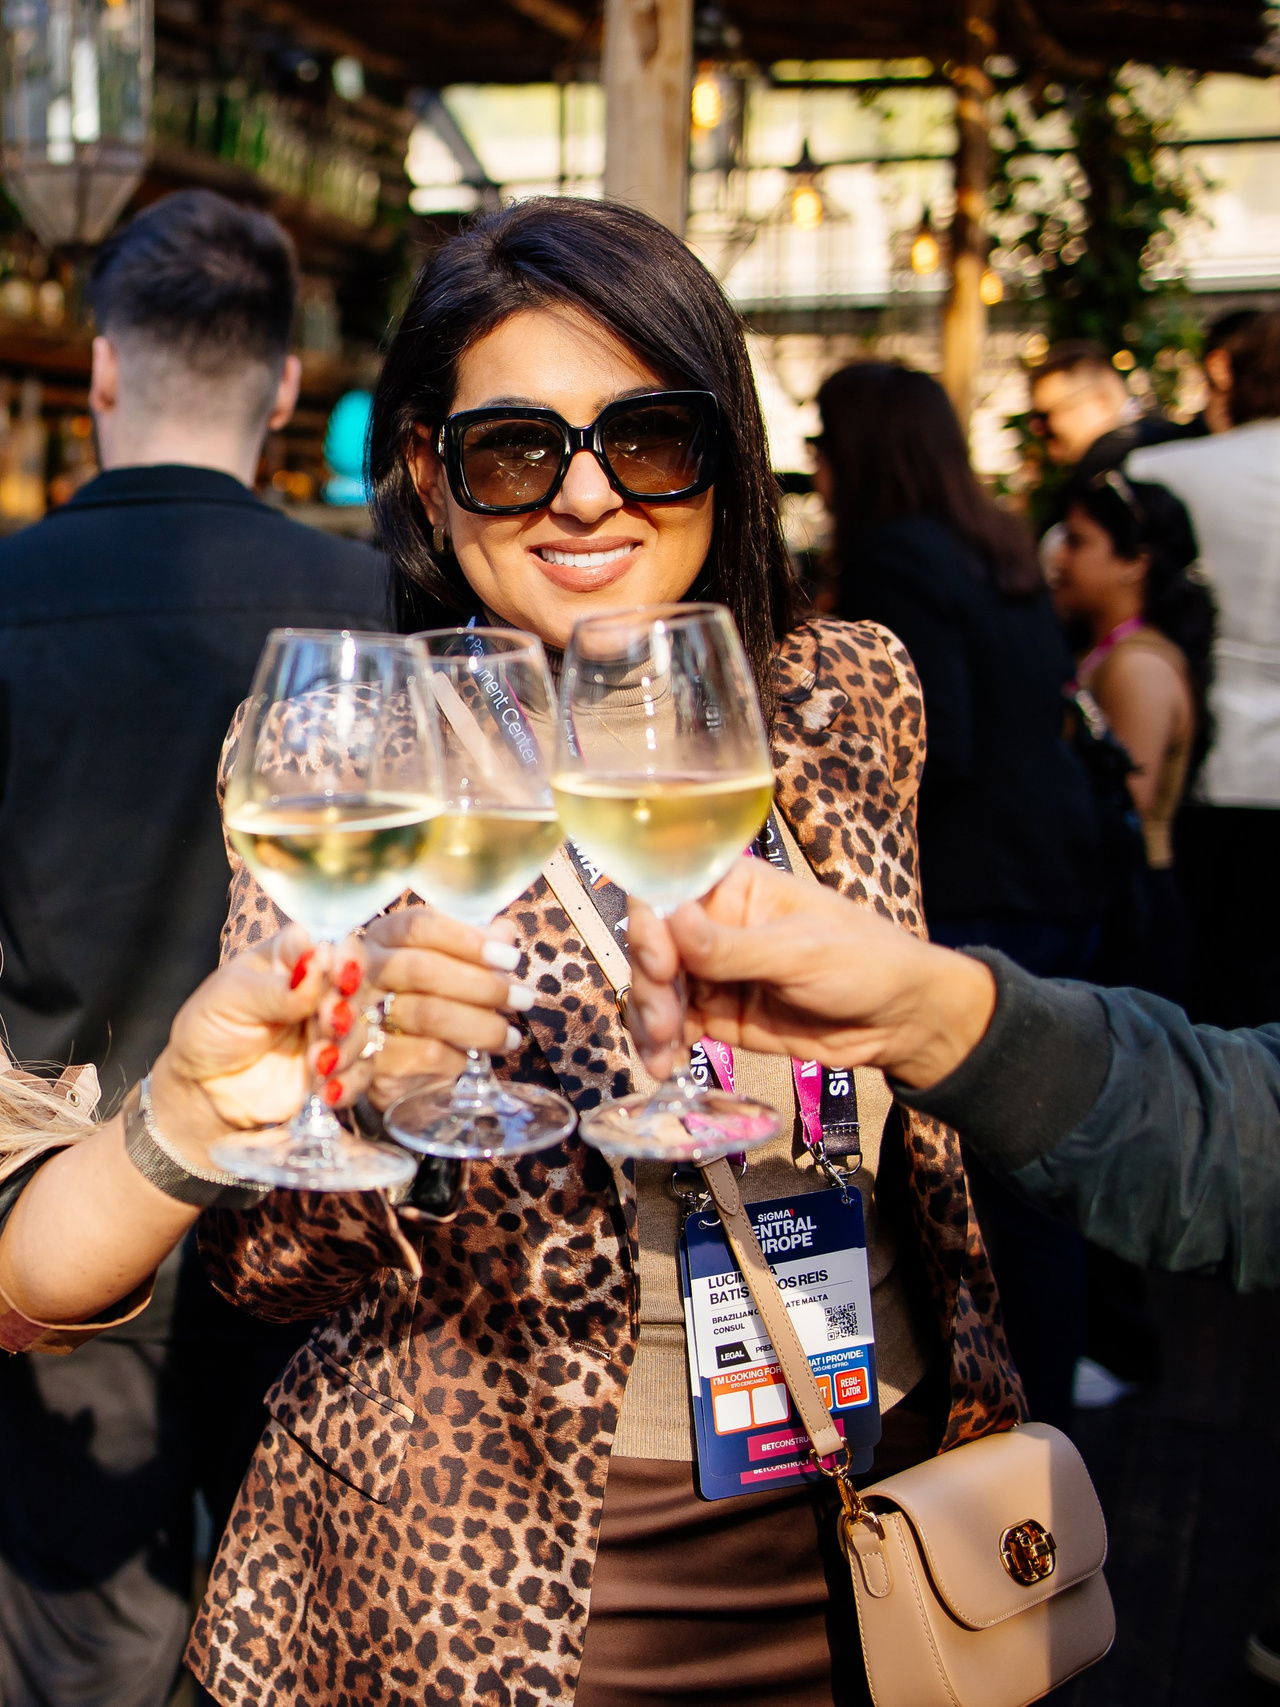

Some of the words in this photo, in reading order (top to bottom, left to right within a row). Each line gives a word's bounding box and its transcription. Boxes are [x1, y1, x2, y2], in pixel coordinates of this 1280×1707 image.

[501, 707, 538, 766] Center
[757, 1209, 791, 1223] SiGMA
[752, 1216, 818, 1240] ENTRAL
[761, 1231, 814, 1254] UROPE
[709, 1286, 750, 1305] BATIS
[798, 1269, 829, 1287] REIS
[712, 1309, 754, 1325] BRAZILIAN
[801, 1293, 829, 1305] MALTA
[713, 1322, 746, 1335] CONSUL
[720, 1350, 745, 1362] LEGAL
[825, 1349, 864, 1364] PROVIDE:
[713, 1377, 725, 1386] I'M
[725, 1369, 764, 1384] LOOKING
[840, 1376, 862, 1388] REGU-
[841, 1385, 862, 1398] LATOR
[761, 1435, 812, 1452] BETCONSTRU
